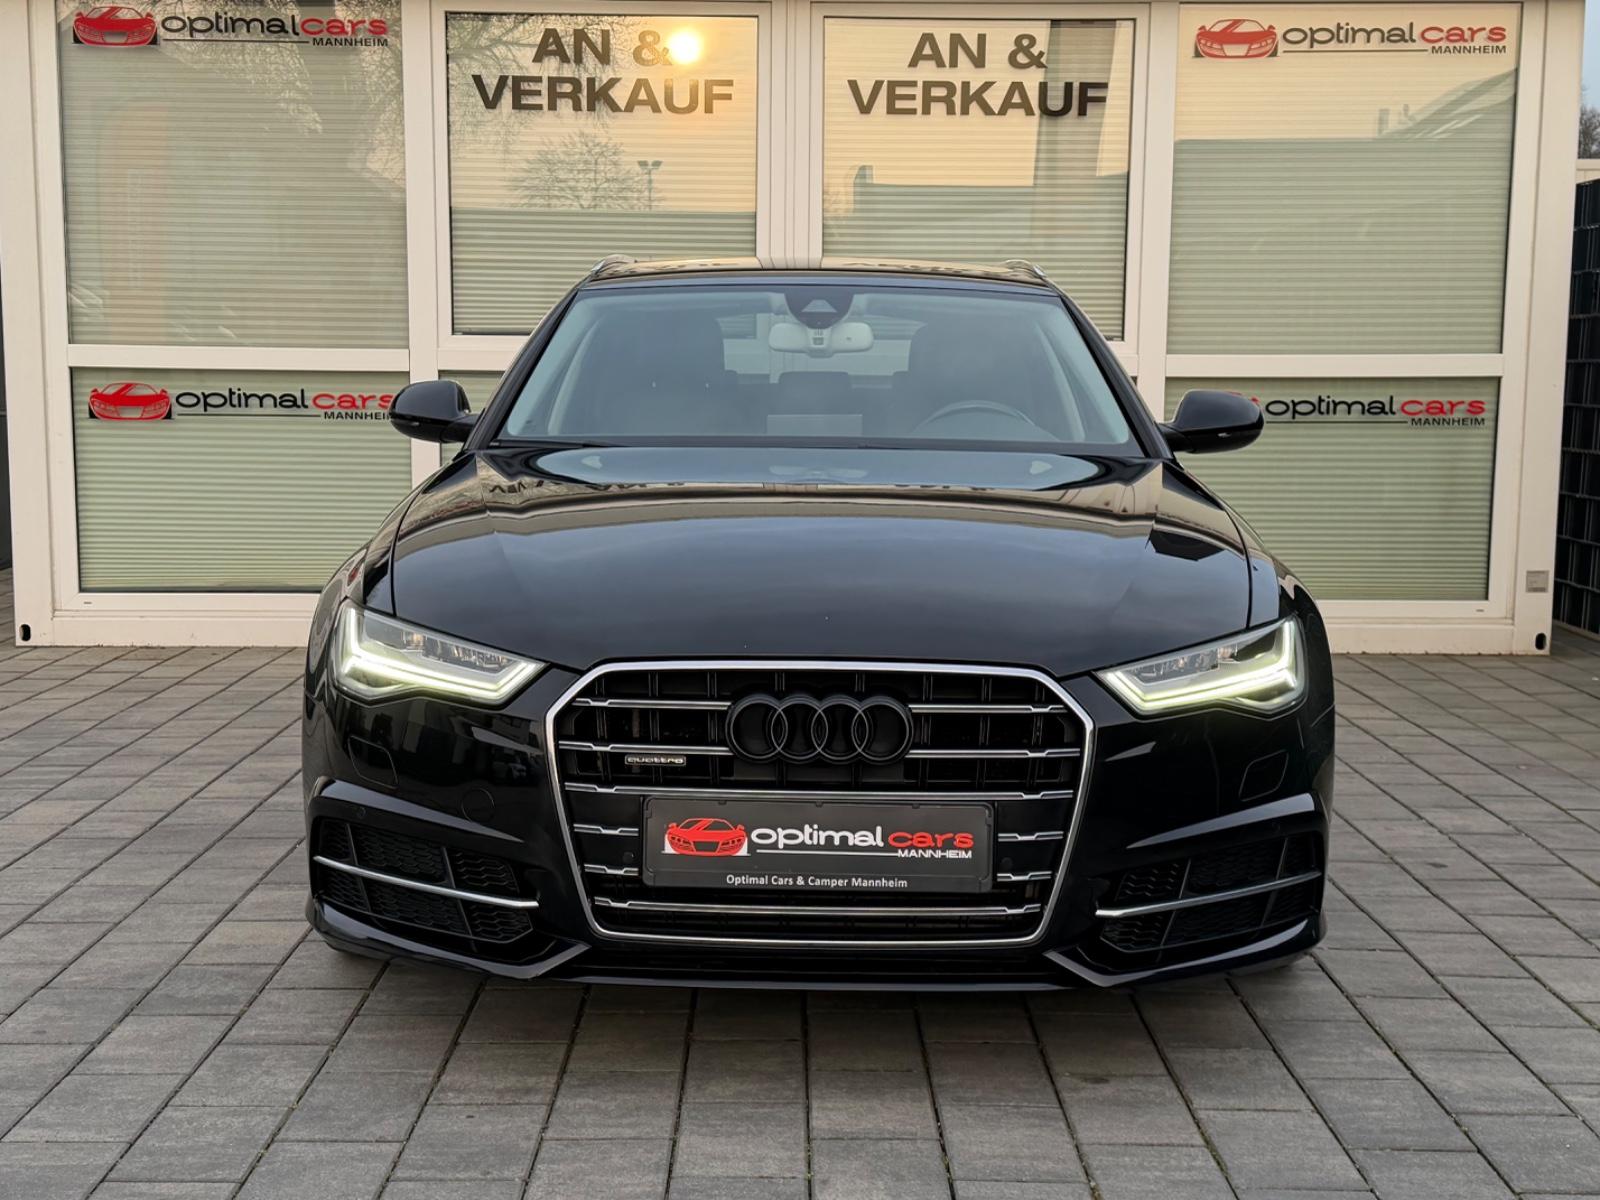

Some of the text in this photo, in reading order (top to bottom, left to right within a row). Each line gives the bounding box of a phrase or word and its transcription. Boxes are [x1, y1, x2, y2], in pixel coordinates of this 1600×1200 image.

[312, 37, 389, 47] MANNHEIM
[532, 28, 673, 67] AN &
[1282, 22, 1507, 49] optimal cars
[907, 32, 1048, 69] AN &
[1431, 45, 1507, 55] MANNHEIM
[471, 74, 735, 114] VERKAUF
[847, 79, 1109, 117] VERKAUF
[175, 388, 309, 412] optimal
[1265, 395, 1486, 419] optimal cars
[324, 411, 393, 420] MANNHEI
[1411, 418, 1486, 426] MANNHEIM
[627, 756, 684, 764] quattro
[750, 824, 974, 848] optimal cars
[897, 848, 972, 859] MANNHEIM
[726, 874, 908, 888] Optimal Cars & Camper Mannheim
